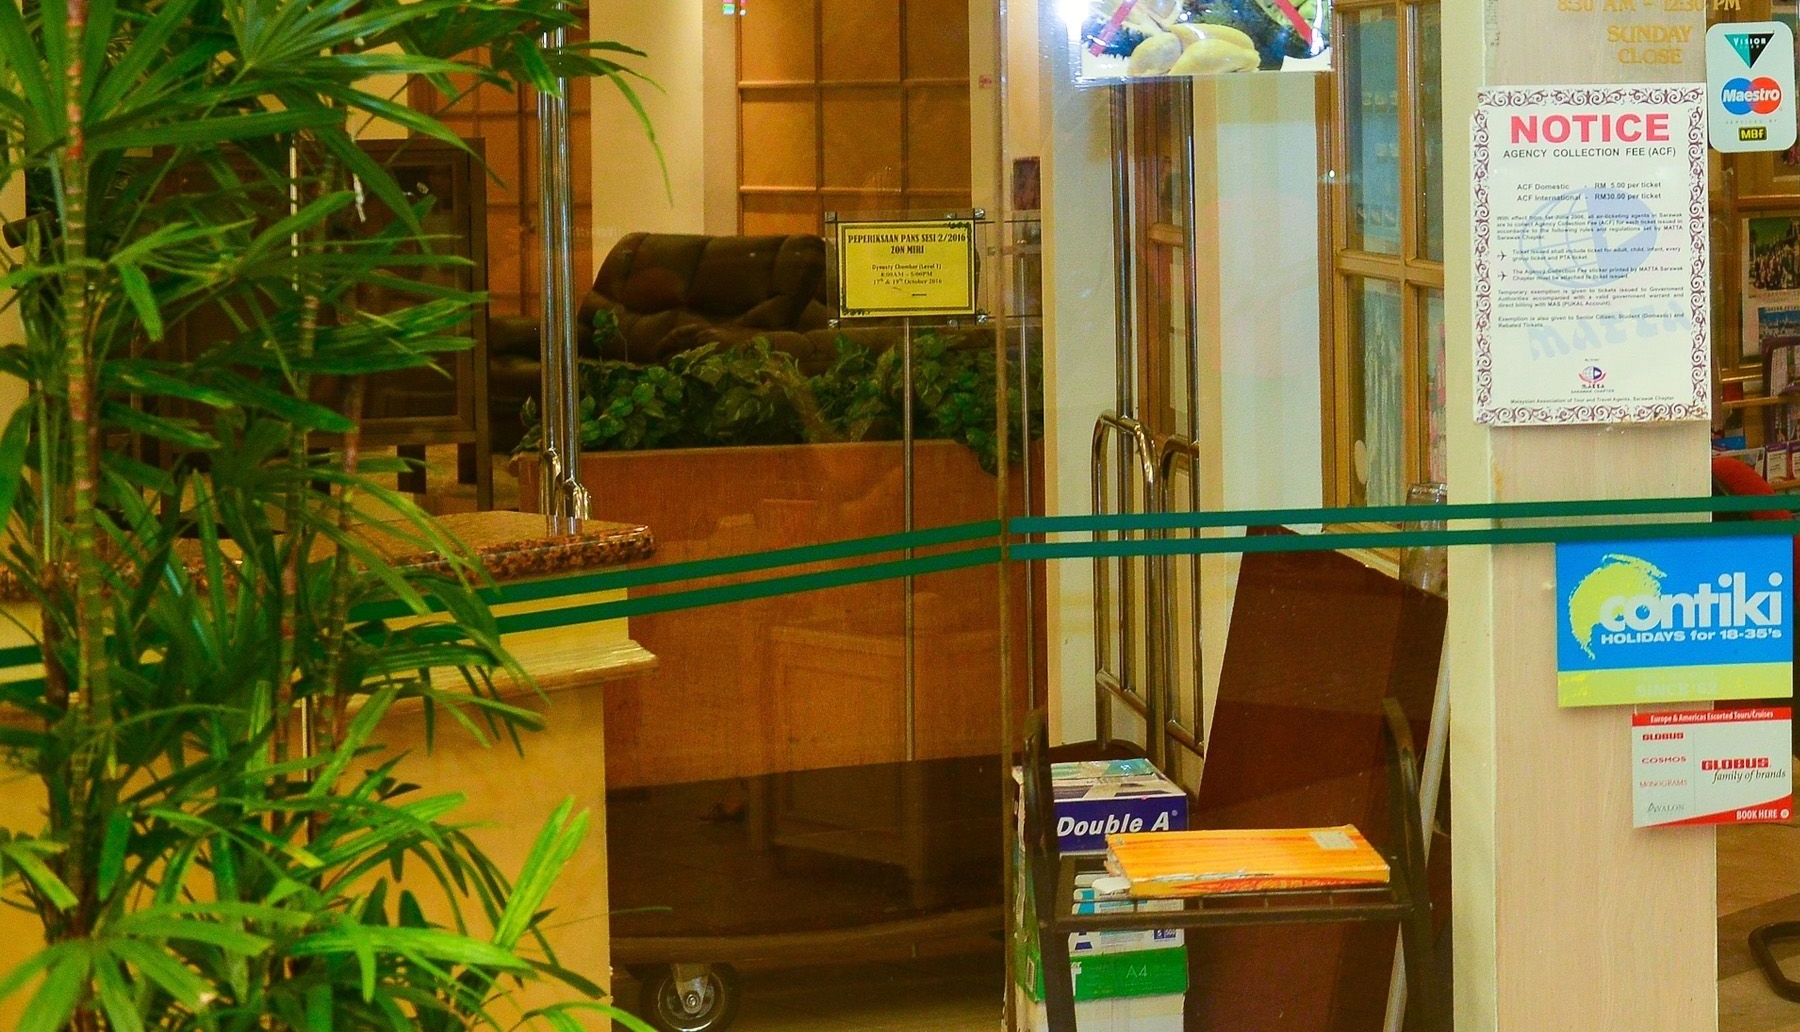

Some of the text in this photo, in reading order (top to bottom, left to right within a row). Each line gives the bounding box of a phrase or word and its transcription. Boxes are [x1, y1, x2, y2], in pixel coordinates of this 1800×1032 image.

[1607, 25, 1693, 43] SUNDAY
[1617, 49, 1683, 64] CLOSE
[1722, 88, 1780, 103] Maestro
[1510, 113, 1670, 144] NOTICE
[1503, 145, 1676, 158] AGENCY COLLECTION FEE (ACF)
[848, 234, 899, 243] PEPERIKSAAN
[921, 234, 936, 243] SESI
[938, 233, 966, 242] 2/2016
[890, 245, 924, 254] ZON MIRI
[1600, 571, 1783, 632] contiki
[1650, 710, 1774, 724] Europe & Americas Escorted Tours/Cruises
[1702, 758, 1769, 770] GLOBUS
[1712, 768, 1786, 784] family of brands
[1736, 809, 1778, 820] BOOK HERE
[1056, 811, 1170, 838] Double A
